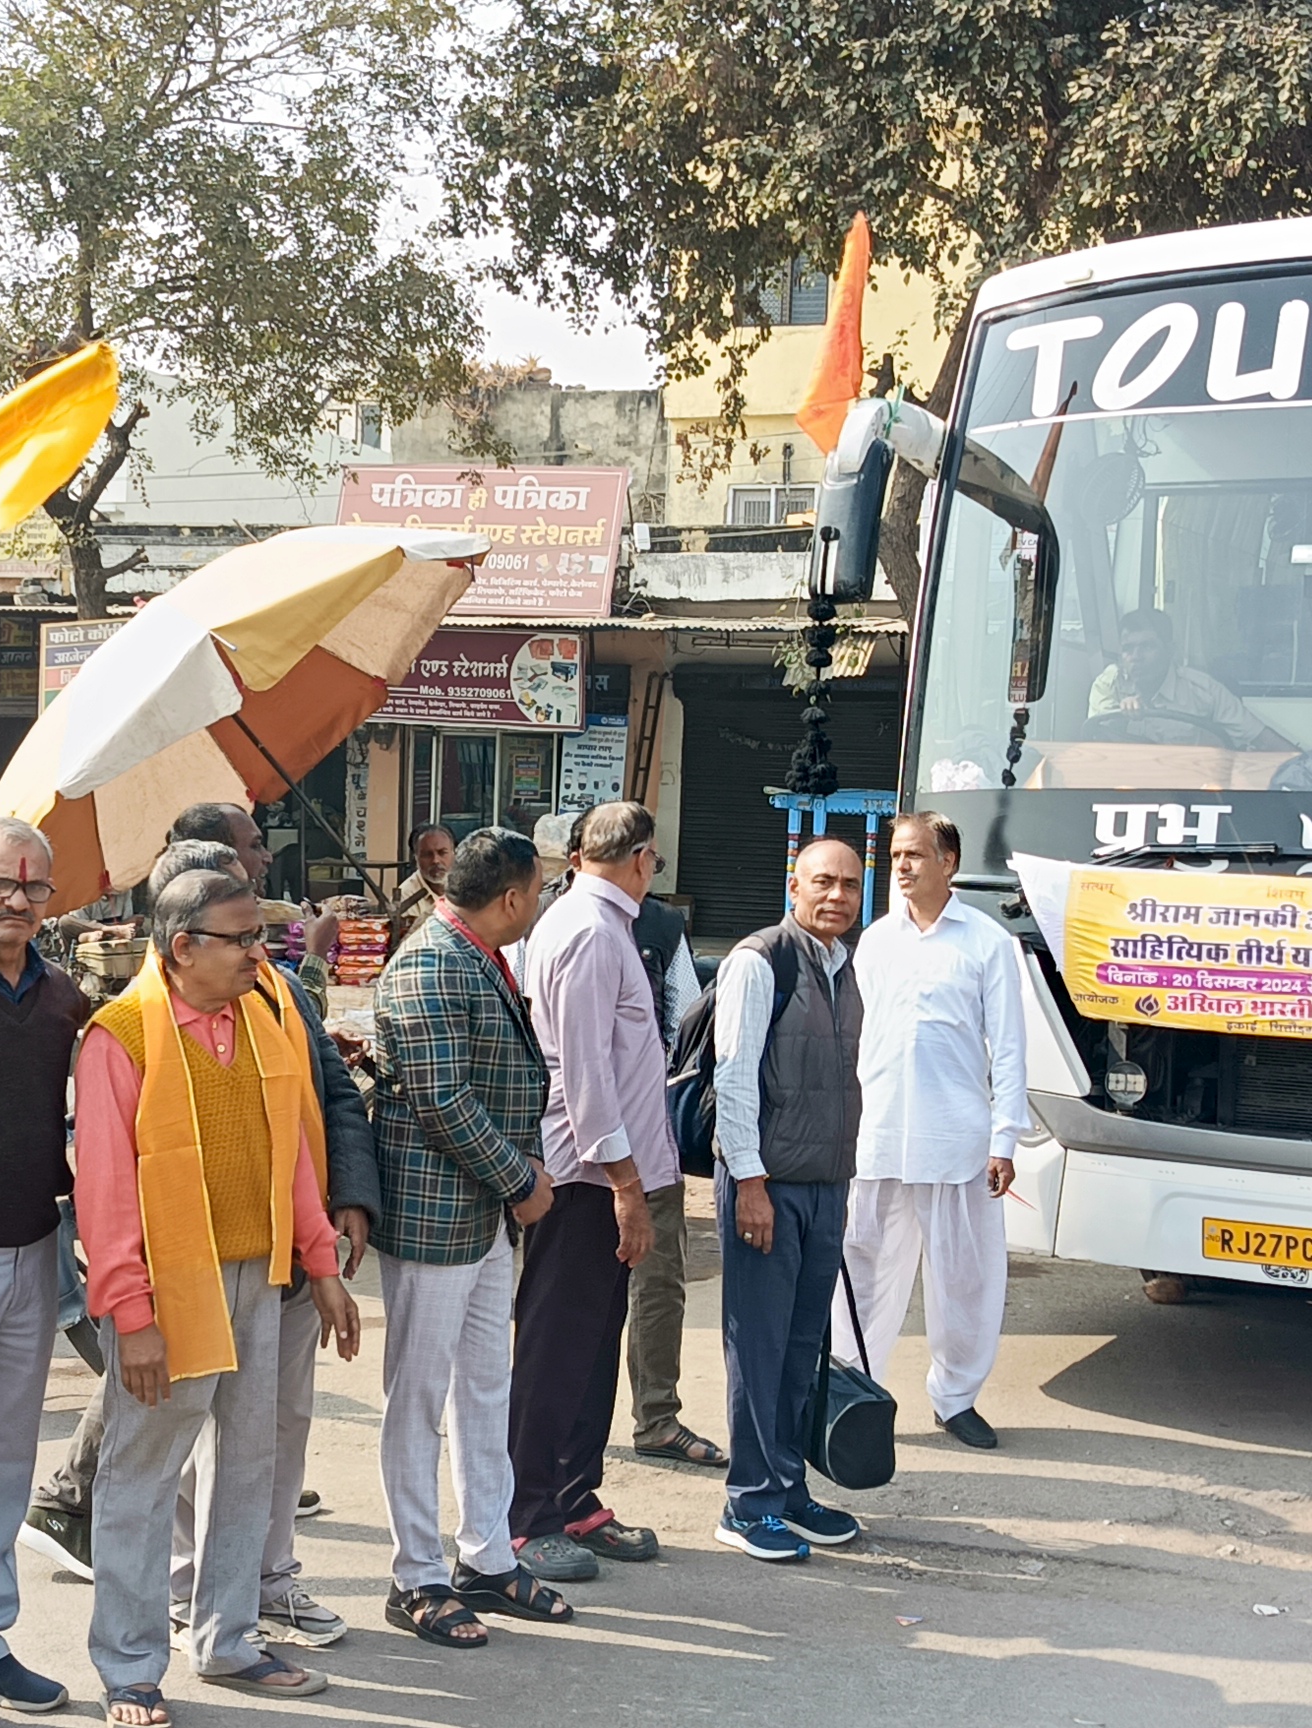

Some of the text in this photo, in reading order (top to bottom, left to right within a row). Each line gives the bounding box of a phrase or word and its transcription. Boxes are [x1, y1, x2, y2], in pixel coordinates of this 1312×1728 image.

[371, 473, 591, 511] पत्रिका ही पत्रिका
[520, 517, 607, 546] स्टेशनर्स
[48, 627, 85, 643] फोटो
[420, 660, 448, 677] एण्ड
[452, 653, 509, 679] स्टेशनर्स
[419, 685, 511, 699] Mob. 9352709061
[1126, 898, 1202, 926] श्रीराम
[1207, 903, 1299, 930] जानकी
[1110, 933, 1230, 964] साहित्यिक
[1236, 938, 1287, 967] तीर्थ
[1107, 966, 1159, 986] दिनांक
[1172, 974, 1193, 988] 20
[1196, 972, 1258, 991] दिसम्बर
[1261, 978, 1303, 993] 2024
[1166, 993, 1243, 1015] अखिल
